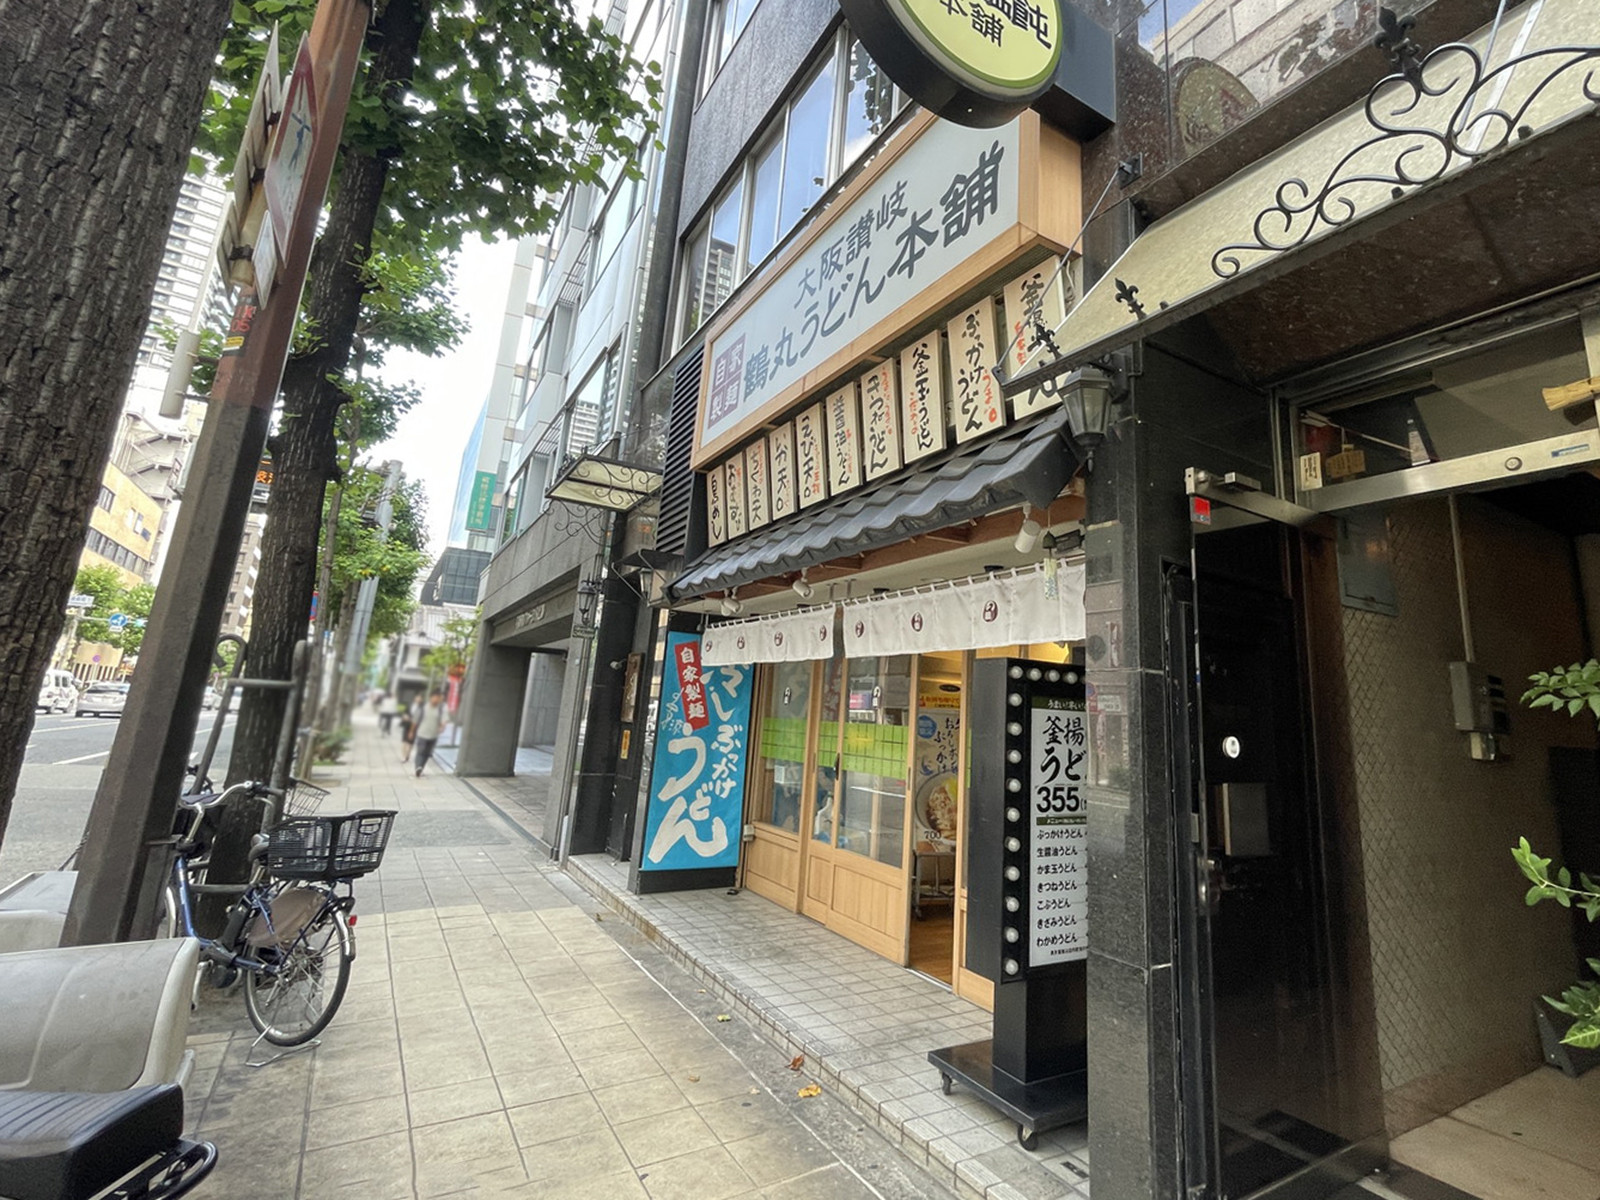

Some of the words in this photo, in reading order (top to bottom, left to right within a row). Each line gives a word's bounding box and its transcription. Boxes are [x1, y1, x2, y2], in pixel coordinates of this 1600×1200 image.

[744, 140, 1005, 403] 鶴丸うどん本舗
[912, 343, 934, 450] 釜玉うどん
[957, 310, 984, 432] ぶっかけうどん
[868, 375, 888, 473] きつねうどん
[680, 646, 706, 720] 自家製麺
[1041, 747, 1087, 784] うど
[648, 723, 729, 864] うどん
[1036, 786, 1080, 813] 355
[1037, 864, 1077, 875] かま玉うどん
[1037, 881, 1077, 893] きつねうどん
[1037, 916, 1077, 929] きざみうどん
[1037, 934, 1078, 947] わかめうどん
